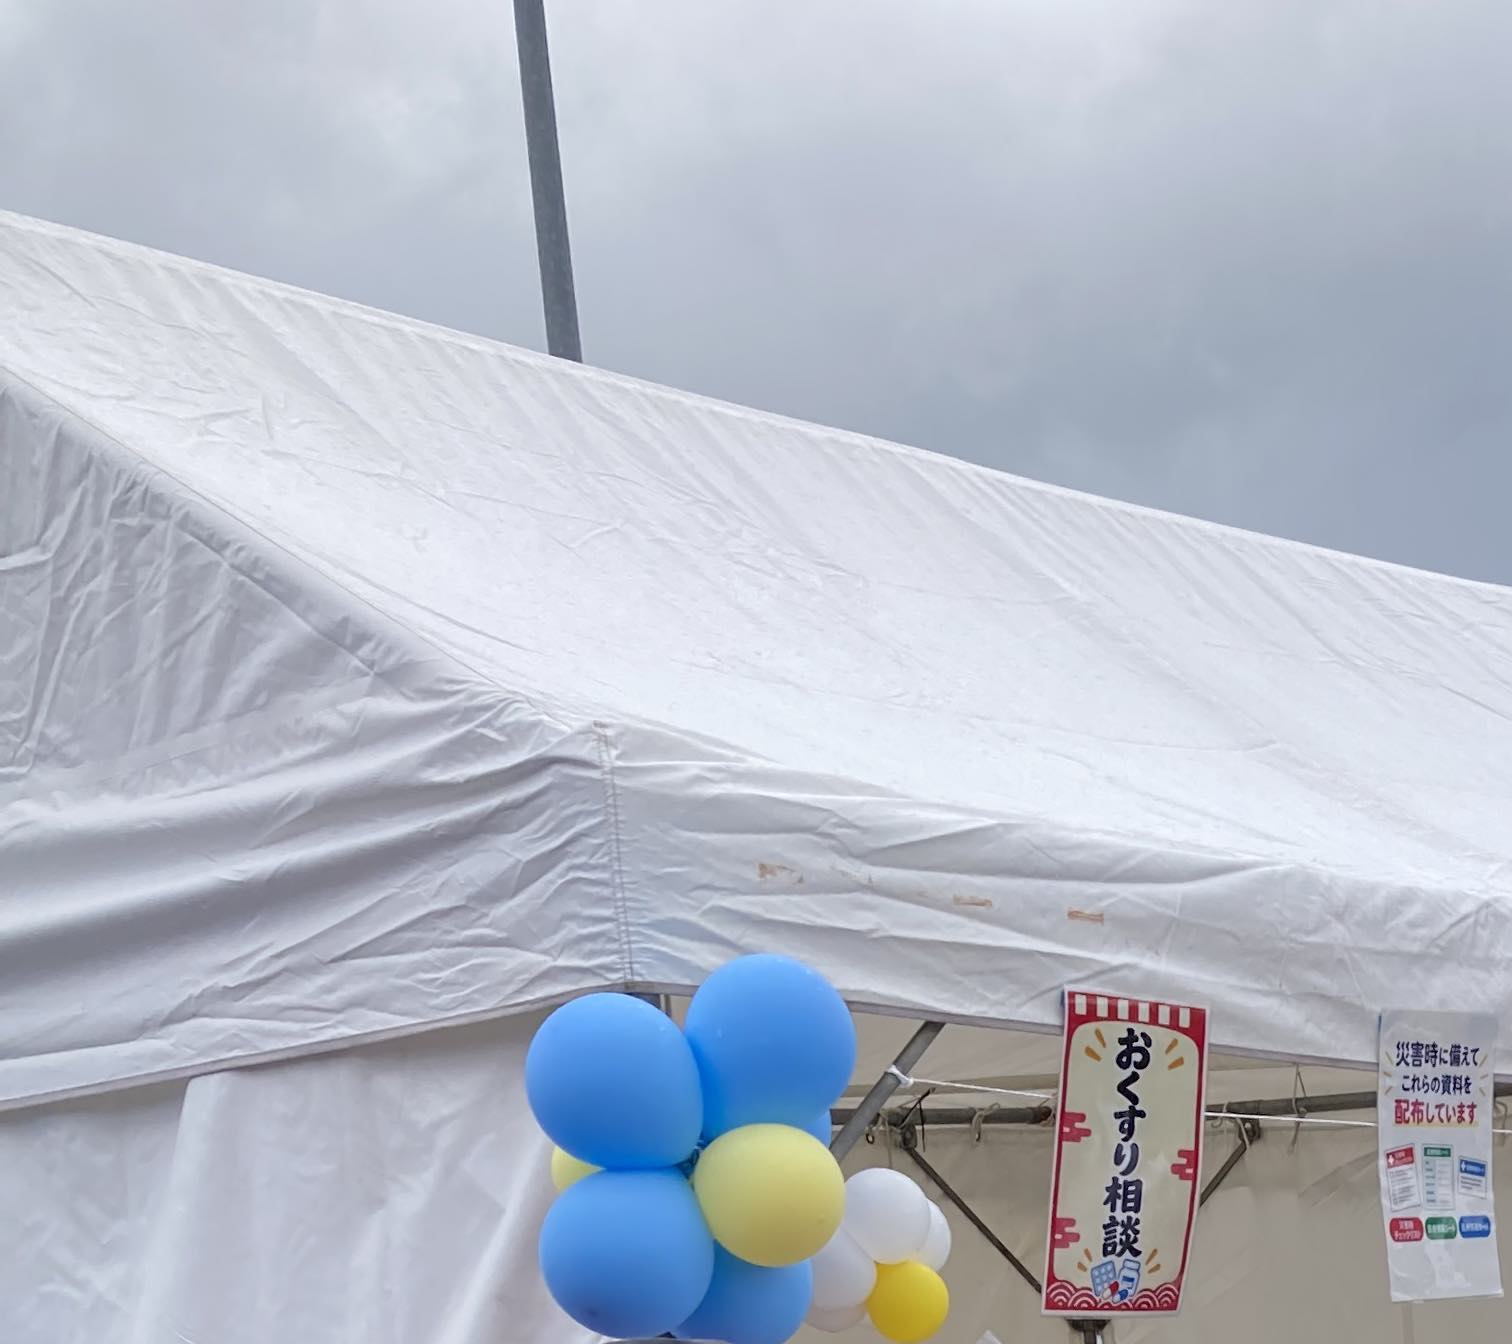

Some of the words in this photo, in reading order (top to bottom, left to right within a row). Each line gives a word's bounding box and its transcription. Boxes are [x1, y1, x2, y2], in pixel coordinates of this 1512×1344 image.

[1395, 1040, 1480, 1068] 災害時に備えて
[1402, 1074, 1472, 1096] これらの資料を
[1394, 1098, 1478, 1125] 配布しています
[1102, 1027, 1152, 1260] おくすり相談
